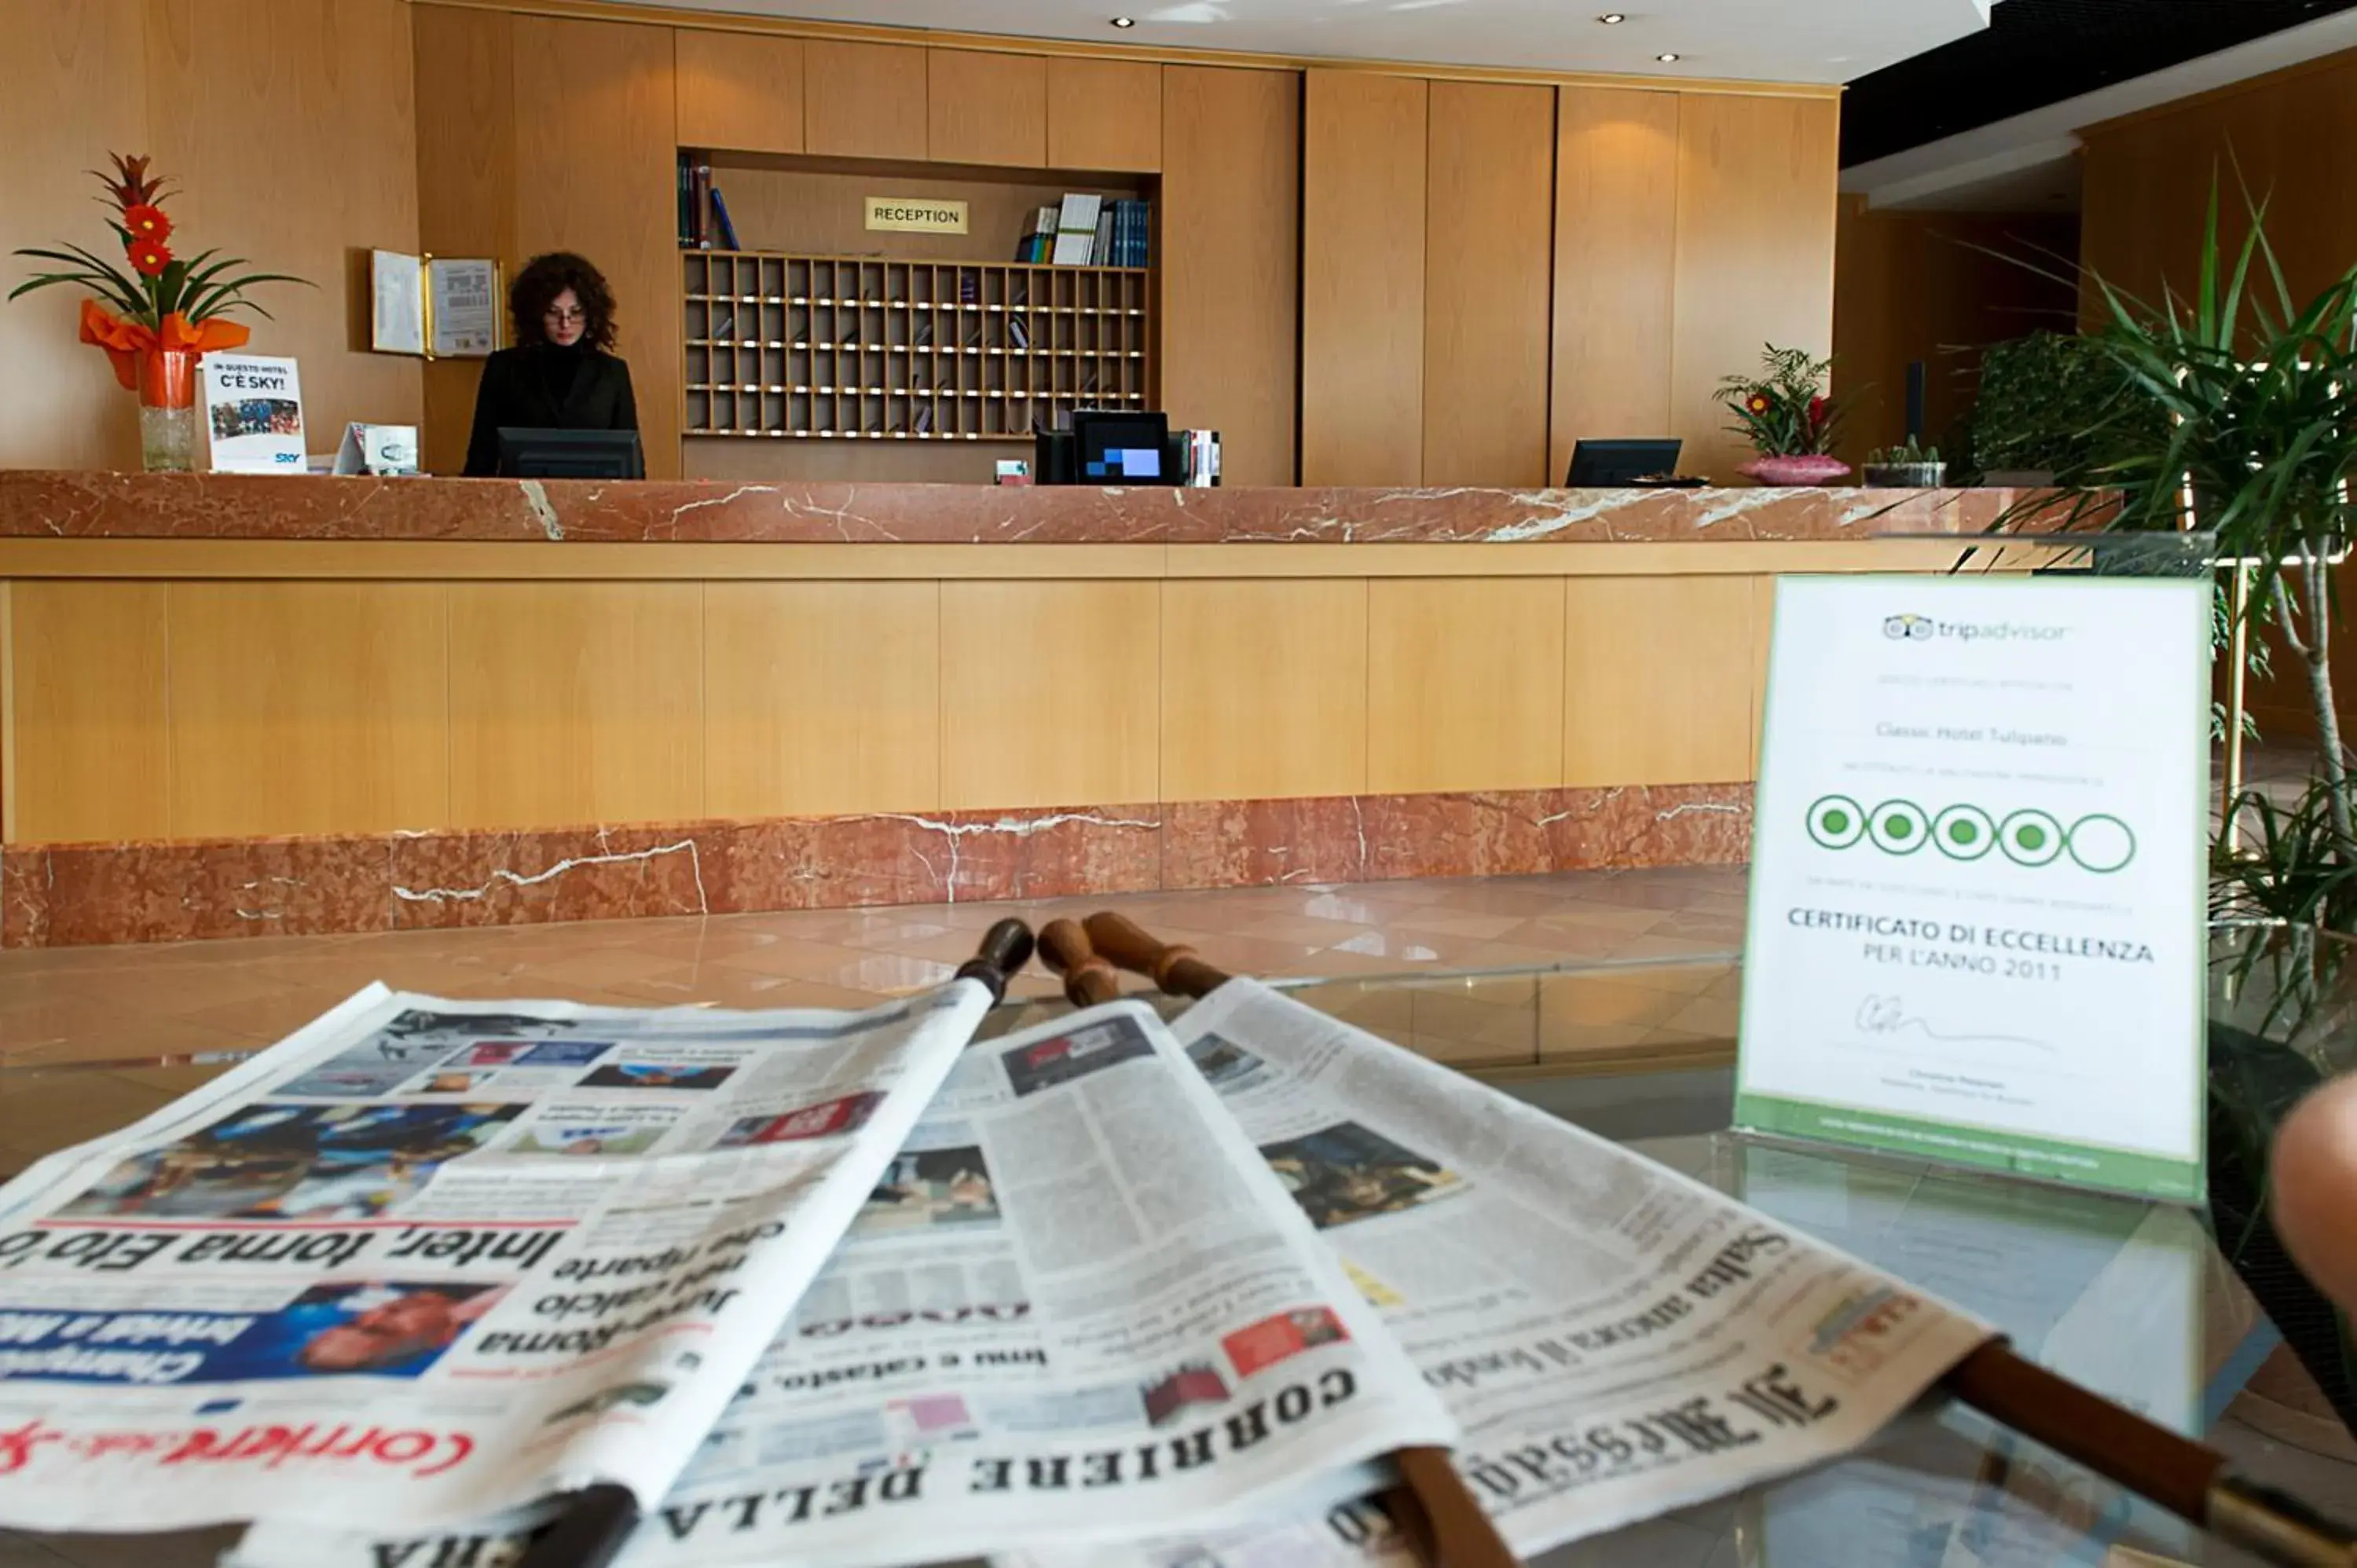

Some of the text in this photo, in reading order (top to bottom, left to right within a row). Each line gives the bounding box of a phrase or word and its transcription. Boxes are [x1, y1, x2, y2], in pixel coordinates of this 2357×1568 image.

[874, 207, 959, 223] RECEPTION
[220, 372, 286, 391] C'È SKY!
[225, 364, 259, 372] QUESTO
[261, 366, 288, 375] HOTEL
[1938, 622, 2066, 642] tripadvisor
[1937, 725, 1984, 741] Hotel
[1787, 907, 2155, 963] CERTIFICATO DI ECCELLENZA
[1863, 942, 2062, 982] PER L'ANNO 2011
[174, 1230, 377, 1271] torna
[396, 1222, 566, 1271] Inter,
[1684, 1229, 1791, 1305] Salta
[1565, 1291, 1693, 1362] ancora
[157, 1423, 476, 1479] Corriere
[968, 1366, 1358, 1495] CORRIERE
[662, 1464, 926, 1544] DELLA
